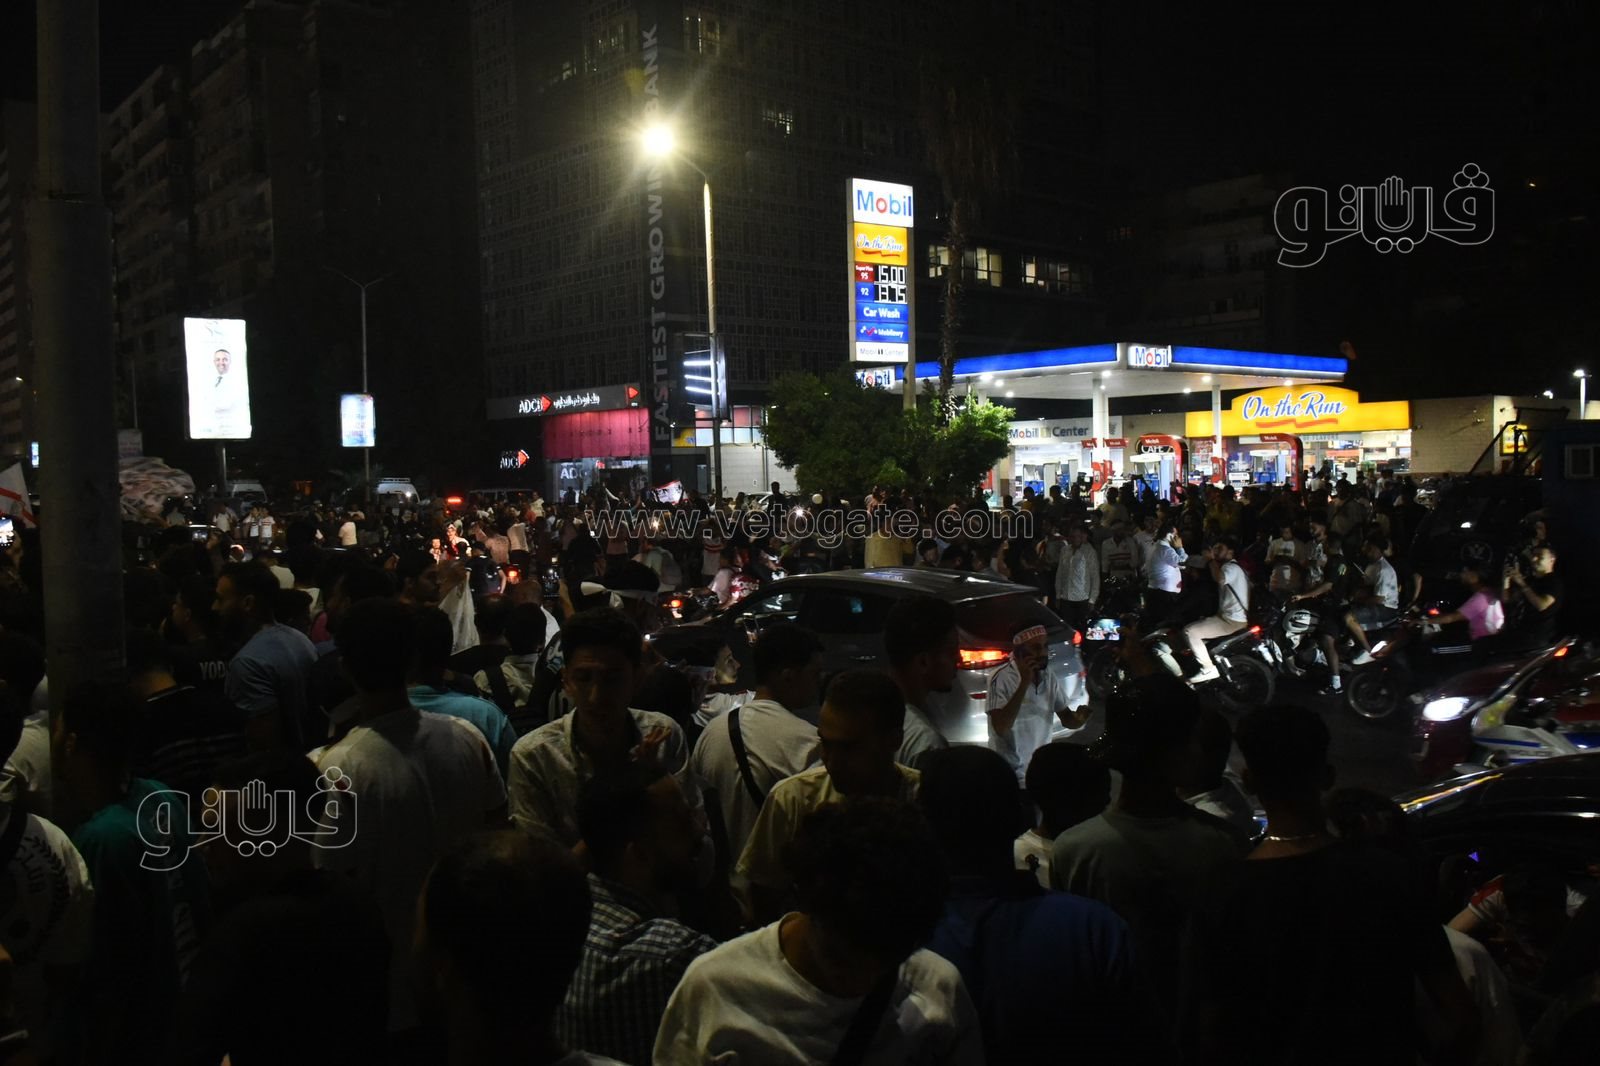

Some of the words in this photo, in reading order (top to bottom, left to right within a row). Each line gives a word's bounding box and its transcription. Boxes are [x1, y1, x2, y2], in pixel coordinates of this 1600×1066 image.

[857, 189, 912, 217] Mobil
[860, 272, 869, 280] 95
[860, 287, 869, 296] 92
[863, 307, 877, 317] Car
[878, 308, 900, 319] Wash
[1134, 347, 1169, 366] Mobil
[651, 306, 670, 441] FASTEST
[518, 398, 543, 414] ADCB
[1243, 396, 1271, 420] On
[1275, 393, 1301, 416] the
[1300, 391, 1345, 418] Run
[1009, 427, 1039, 439] Mobil
[1052, 426, 1088, 437] Center
